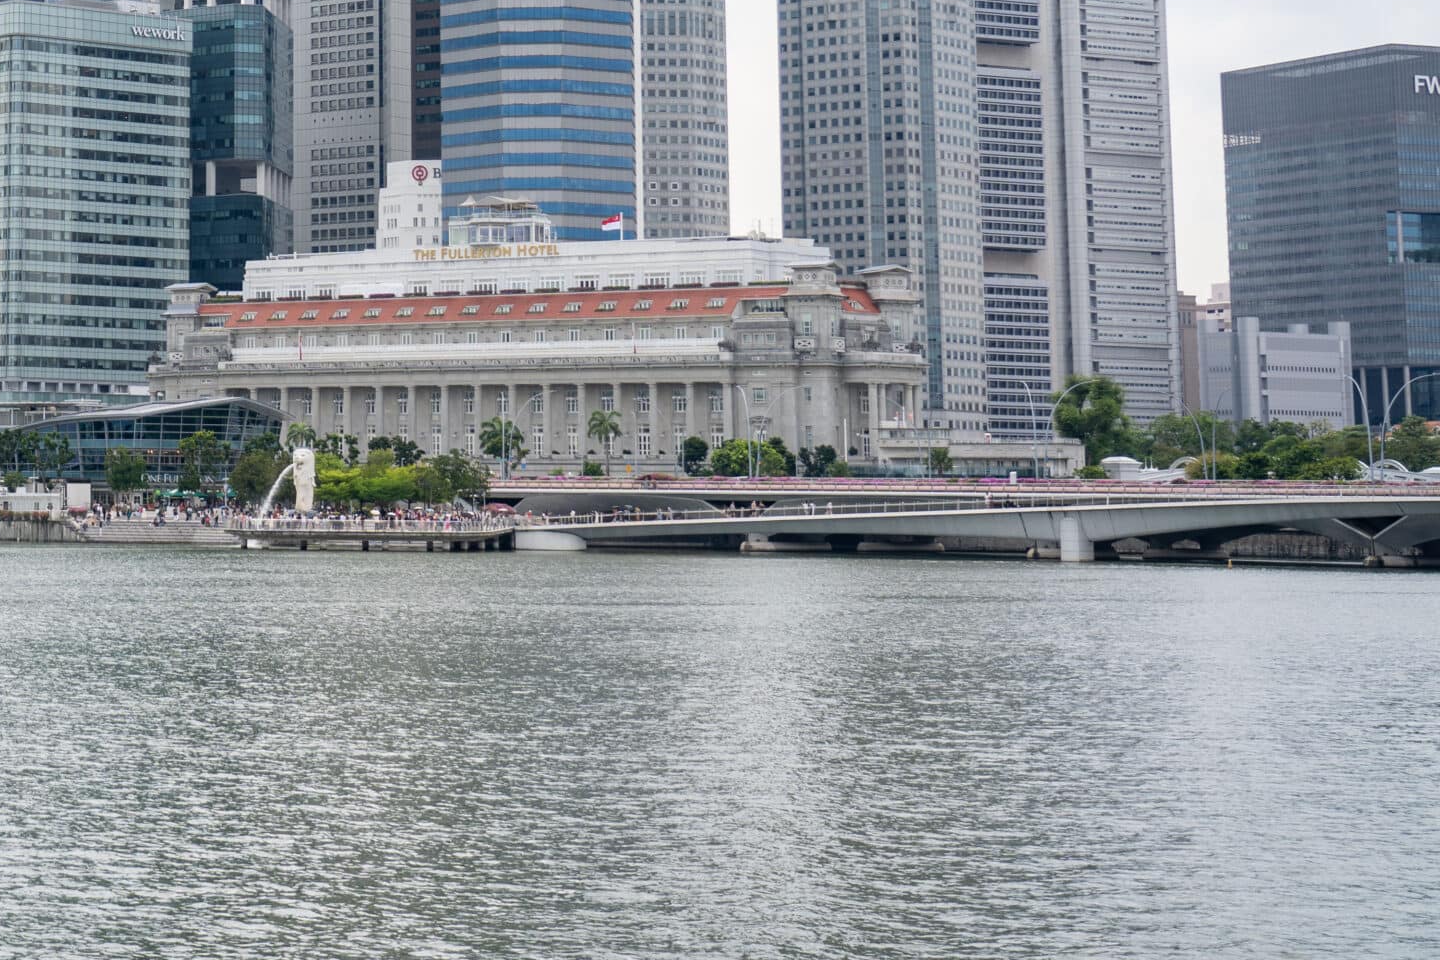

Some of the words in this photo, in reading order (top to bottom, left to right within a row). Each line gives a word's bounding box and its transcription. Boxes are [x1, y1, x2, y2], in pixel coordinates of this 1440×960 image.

[131, 26, 185, 41] wework
[415, 249, 436, 260] THE
[441, 246, 511, 260] FULLERTON
[517, 244, 560, 257] HOTEL
